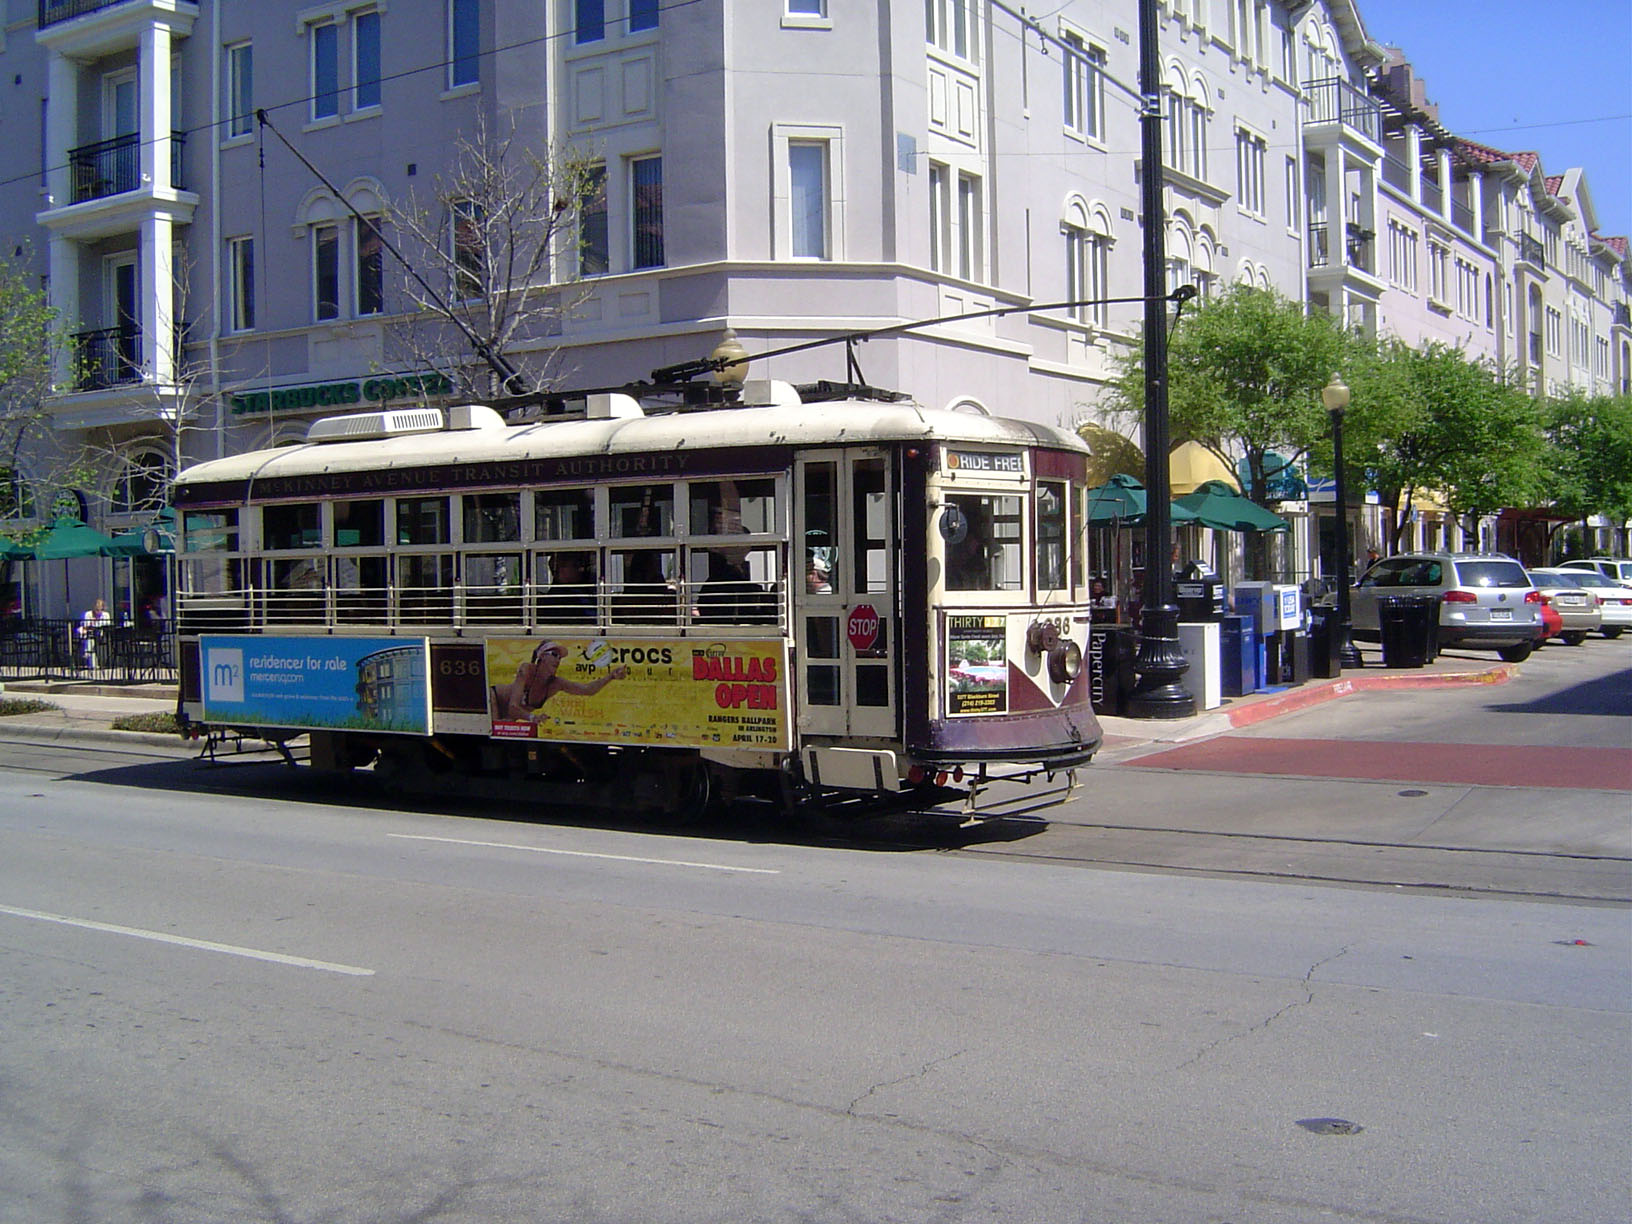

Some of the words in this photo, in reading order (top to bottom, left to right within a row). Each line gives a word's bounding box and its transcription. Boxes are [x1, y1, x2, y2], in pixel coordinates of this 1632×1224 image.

[231, 382, 361, 414] STARBUCKS
[960, 453, 990, 470] RIDE
[362, 470, 440, 487] AVENUE
[452, 463, 544, 482] TRANSIT
[556, 454, 691, 476] AUTHORITY
[849, 619, 877, 636] STOP
[949, 616, 983, 628] THIRTY
[249, 655, 304, 670] residences
[306, 656, 321, 670] for
[324, 656, 348, 671] sale
[611, 648, 673, 664] crocs
[440, 659, 481, 677] 636
[575, 663, 596, 675] avp
[692, 656, 777, 682] DALLAS
[715, 683, 777, 710] OPEN
[708, 714, 739, 724] RANGERS
[741, 715, 776, 725] BALLPARK
[732, 734, 752, 742] APRIL
[755, 735, 777, 744] 17-20
